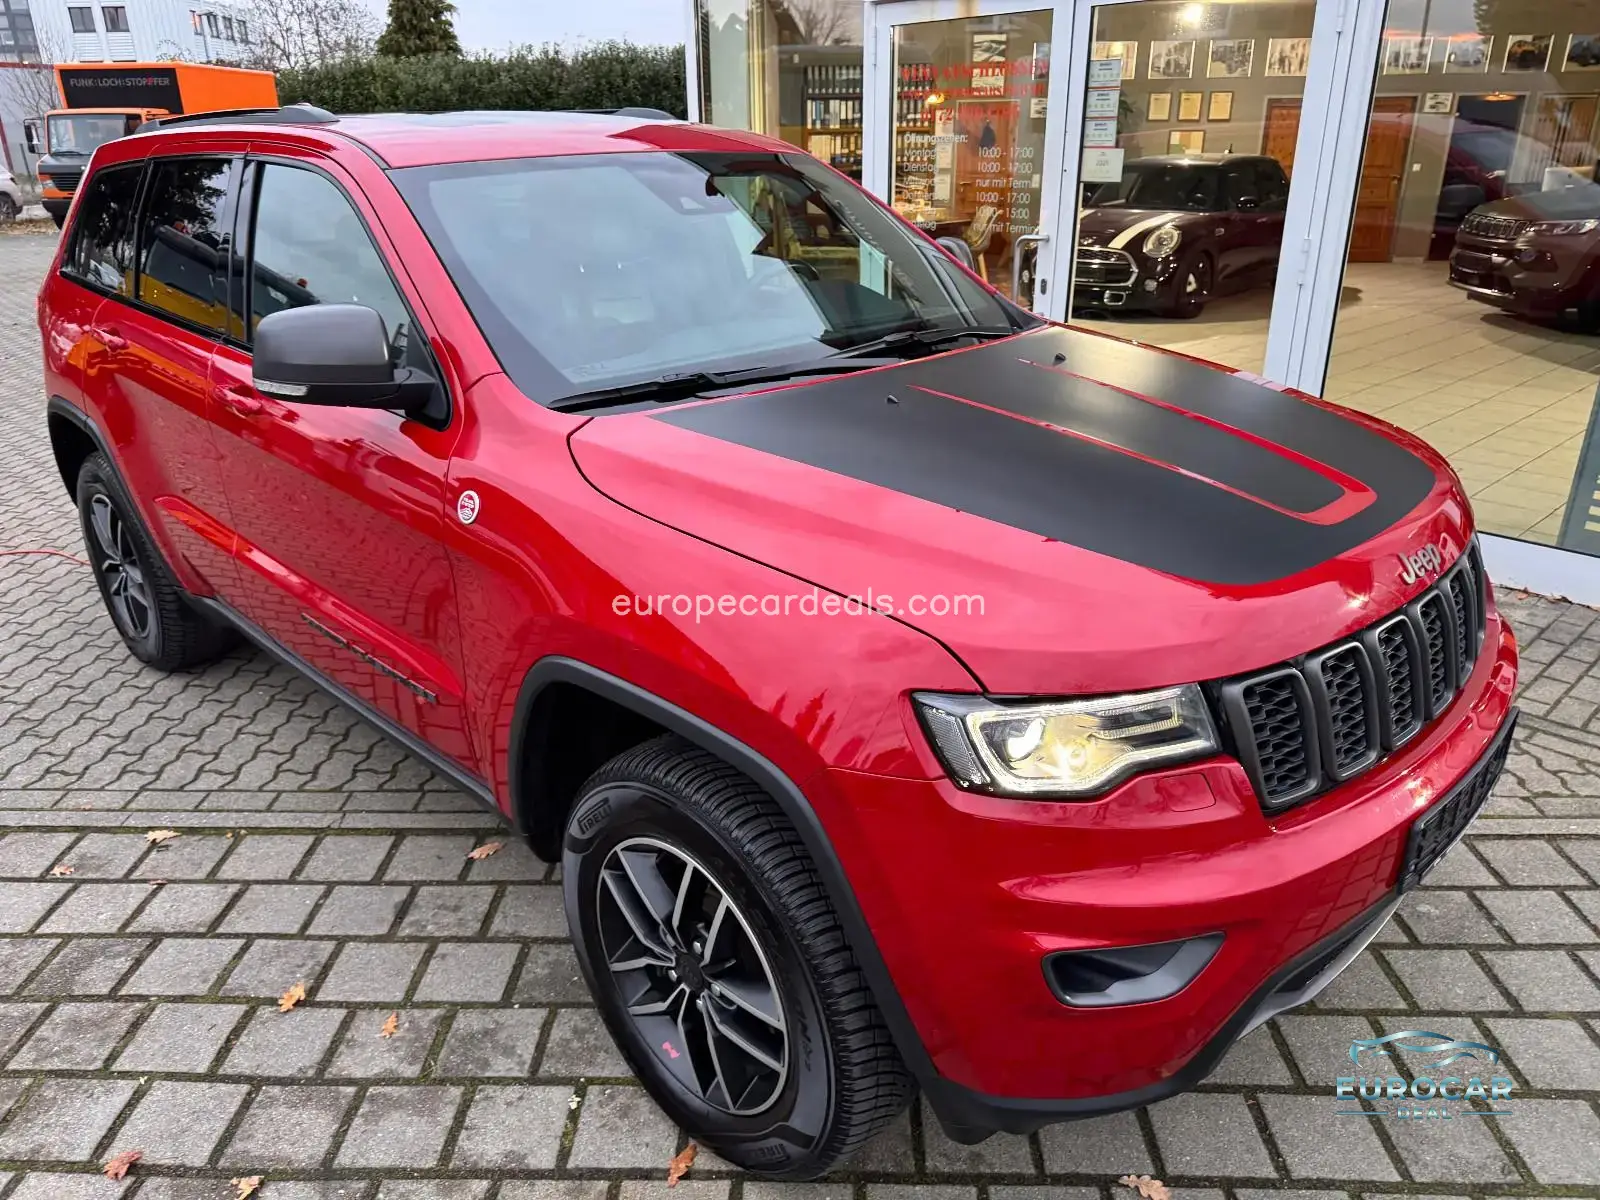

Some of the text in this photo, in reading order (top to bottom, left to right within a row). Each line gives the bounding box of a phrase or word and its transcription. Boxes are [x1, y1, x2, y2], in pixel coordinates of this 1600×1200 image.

[904, 149, 937, 160] Montag
[978, 147, 1001, 158] 10:00
[1010, 147, 1034, 158] 17:00
[903, 162, 938, 174] Dienstag
[977, 162, 1001, 173] 10:00
[1009, 162, 1033, 173] 17:00
[975, 178, 1039, 188] nur mit Term
[976, 191, 998, 202] 10:00
[1007, 192, 1031, 204] 17:00
[1006, 207, 1030, 219] 15:00
[1397, 543, 1441, 584] Jeep
